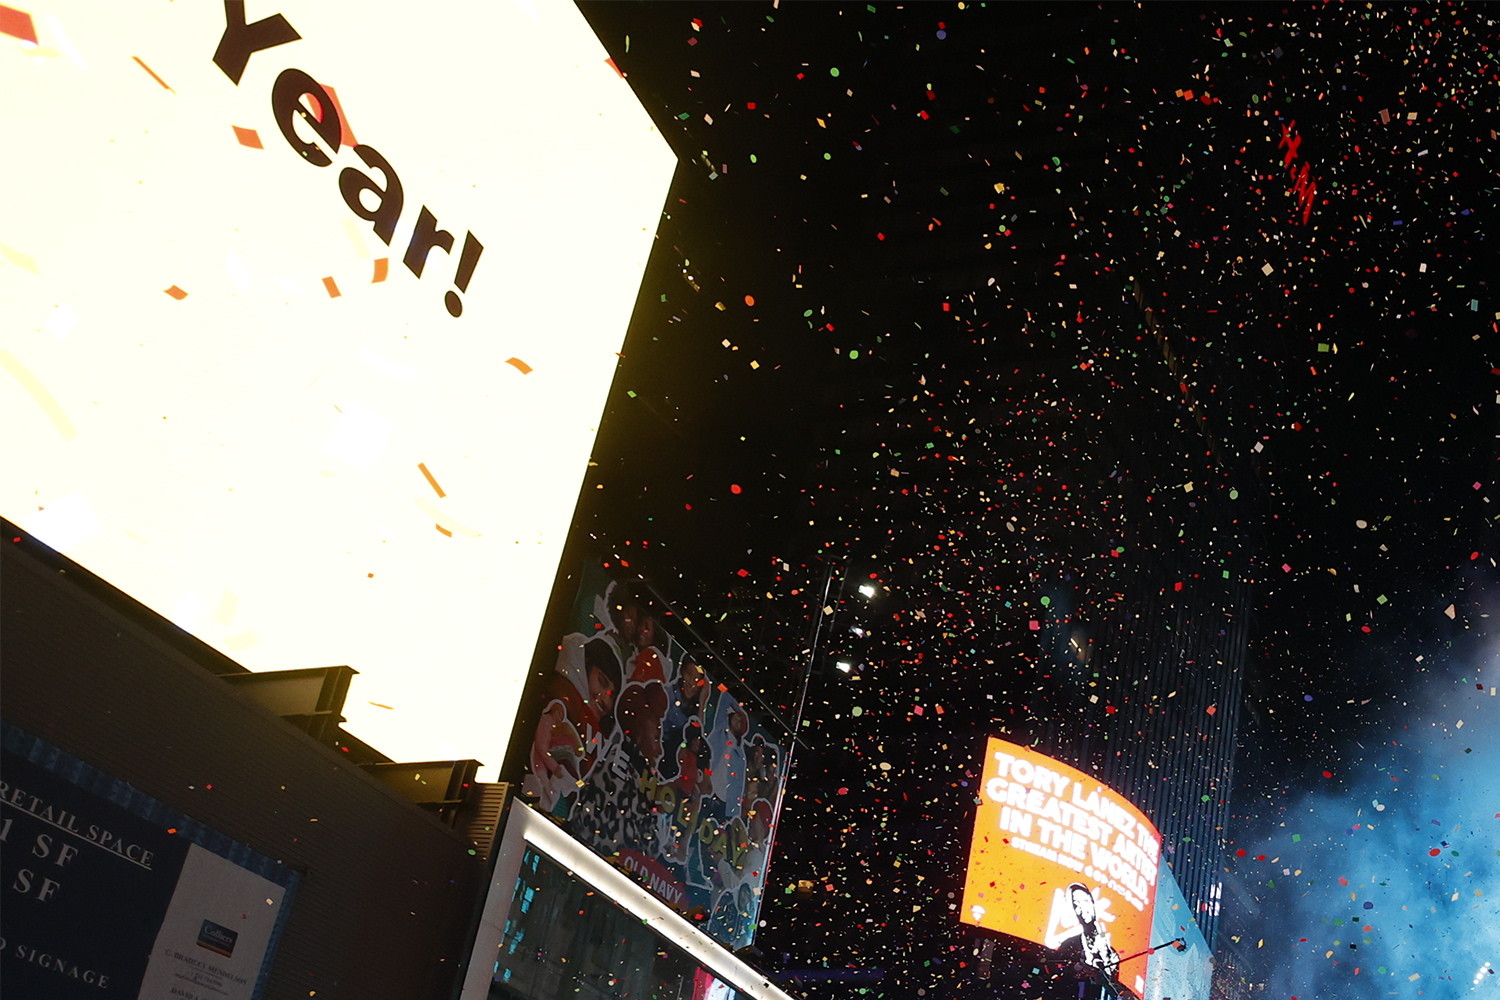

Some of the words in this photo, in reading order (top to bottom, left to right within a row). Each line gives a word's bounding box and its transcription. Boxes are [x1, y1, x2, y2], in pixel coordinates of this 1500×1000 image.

[212, 0, 484, 318] Year!
[986, 778, 1113, 846] GREATEST
[994, 752, 1070, 797] TORY
[1072, 783, 1138, 839] LANEZ
[32, 833, 79, 868] SF
[85, 823, 154, 867] SPACE
[1000, 806, 1033, 838] IN
[1037, 818, 1088, 860] THE
[13, 868, 60, 902] SF
[622, 856, 649, 881] OLD
[649, 869, 682, 904] NAVY
[16, 944, 110, 989] SIGNAGE
